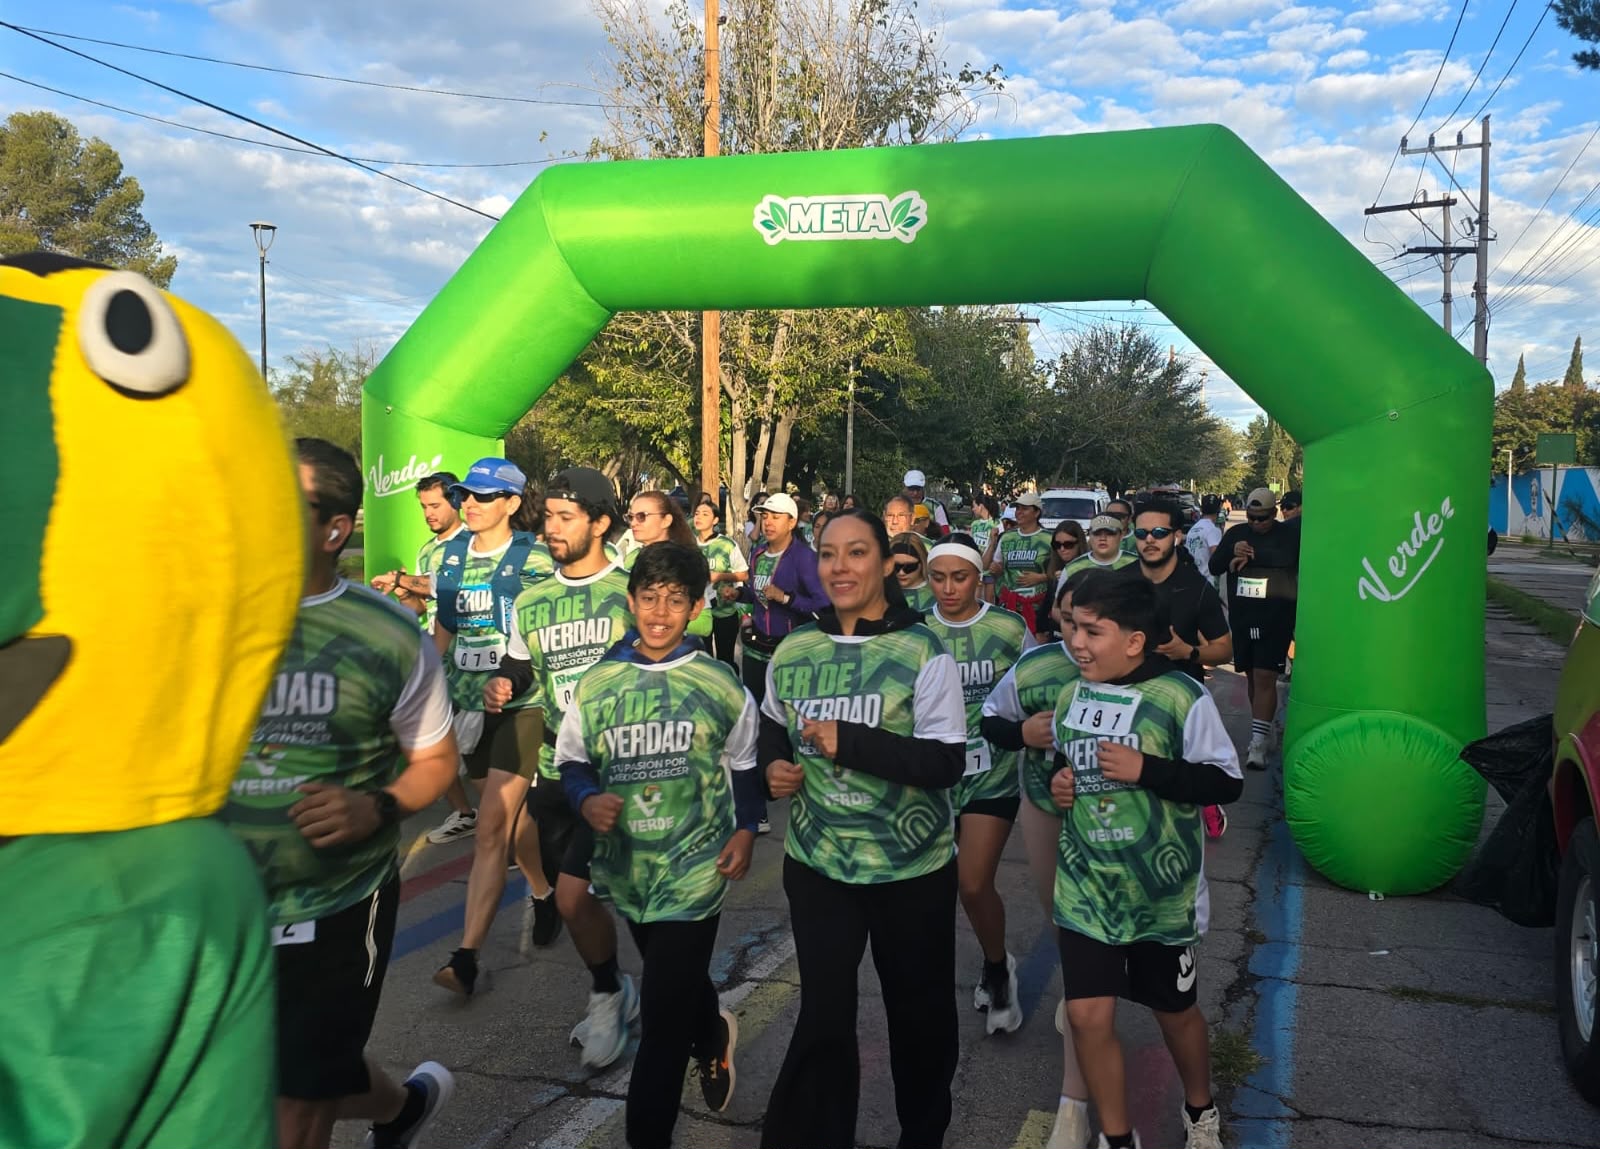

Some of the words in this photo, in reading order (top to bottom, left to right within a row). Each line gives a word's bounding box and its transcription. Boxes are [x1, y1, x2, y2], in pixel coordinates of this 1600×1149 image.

[789, 202, 891, 233] META
[369, 454, 431, 493] Verde
[1359, 510, 1444, 602] Verde
[556, 594, 586, 624] DE
[538, 617, 611, 654] VERDAD
[461, 651, 497, 667] 079
[588, 647, 606, 656] POR
[817, 662, 856, 696] DE
[958, 660, 994, 687] DAD
[624, 688, 664, 723] DE
[1079, 707, 1122, 730] 191
[604, 721, 694, 760] VERDAD
[649, 767, 689, 779] CRECER
[665, 757, 687, 768] POR
[628, 816, 675, 833] VERDE
